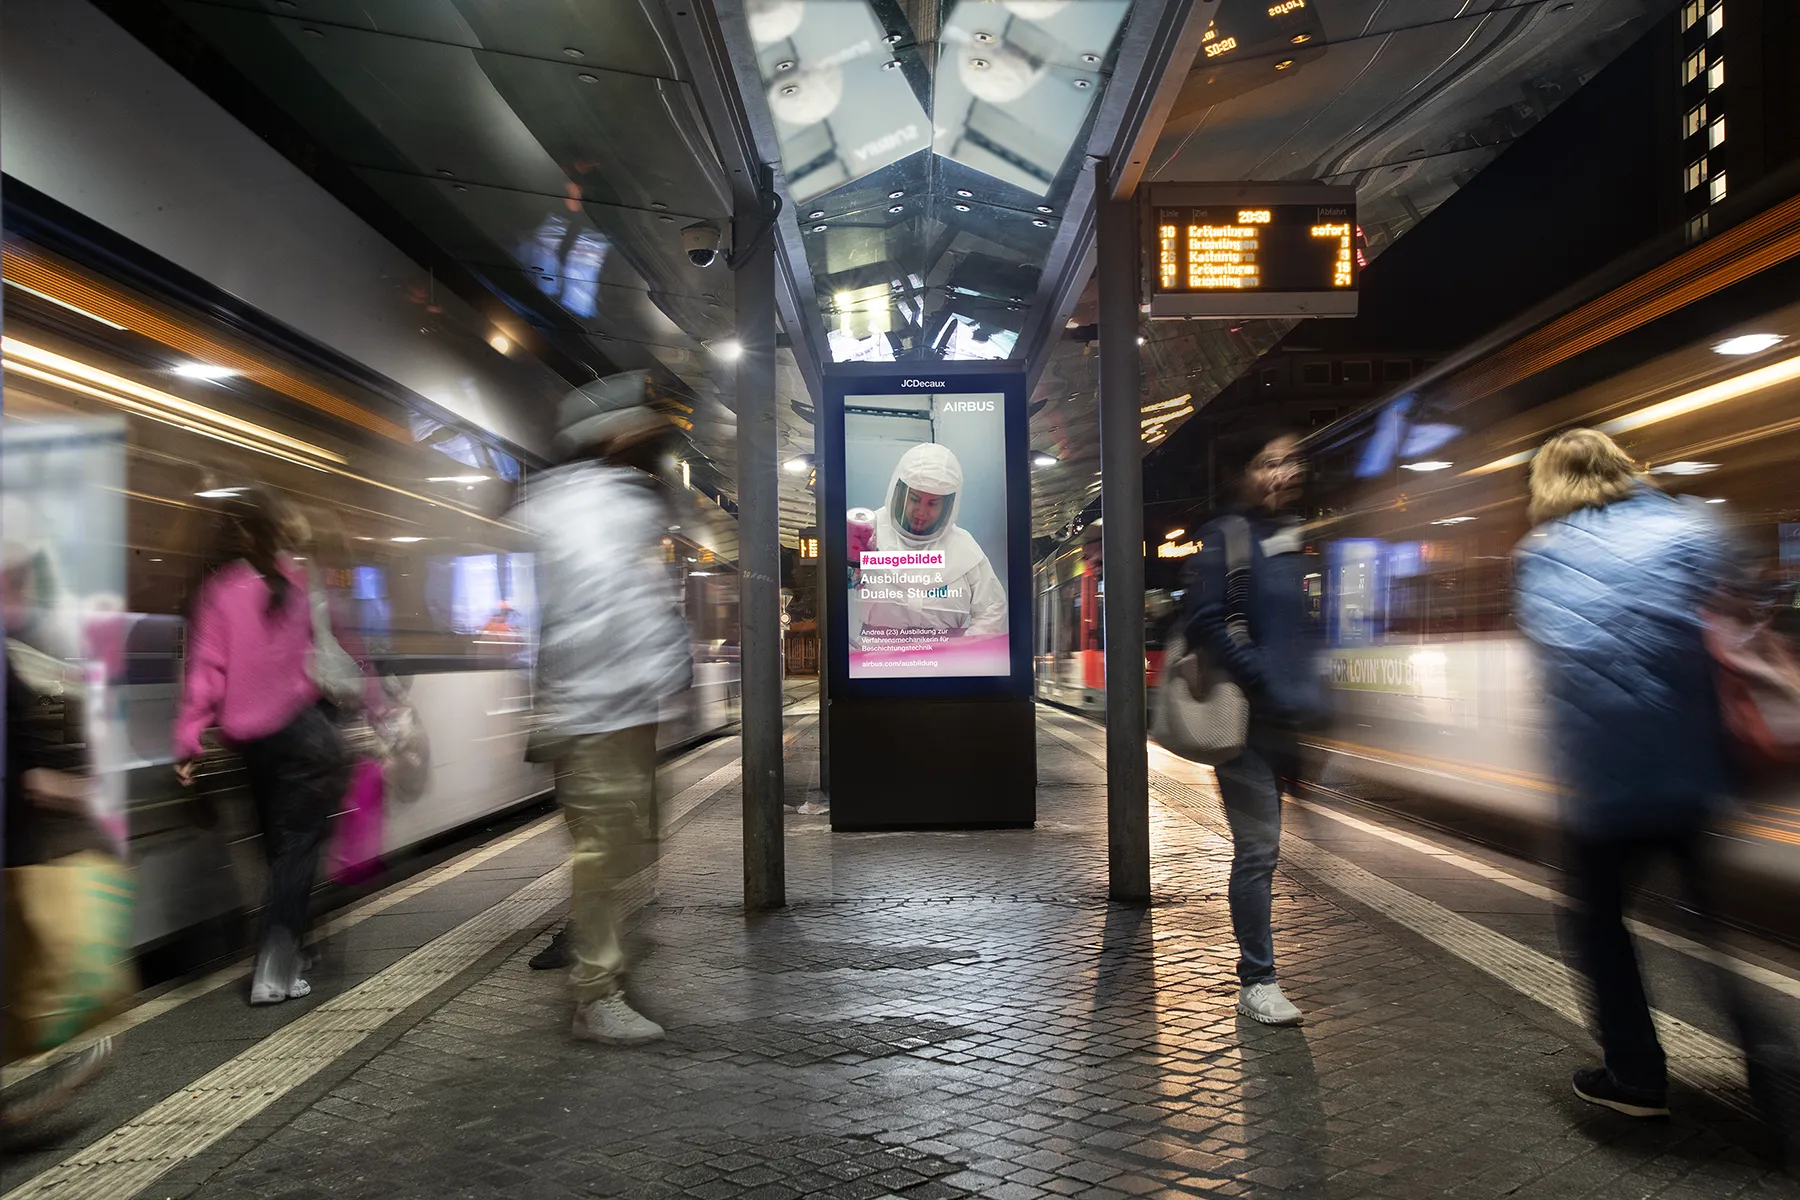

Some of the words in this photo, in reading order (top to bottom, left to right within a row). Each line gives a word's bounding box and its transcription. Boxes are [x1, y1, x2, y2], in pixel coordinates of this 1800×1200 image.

[1319, 208, 1347, 216] Abfahrt
[1311, 223, 1350, 237] sofort
[900, 379, 946, 388] JCDecaux
[942, 401, 995, 412] AIRBUS
[862, 553, 943, 567] #ausgebildet
[860, 573, 931, 585] Ausbildung
[934, 572, 943, 583] &
[861, 588, 904, 599] Duales
[907, 586, 963, 598] Studium!
[886, 629, 899, 637] (23)
[900, 628, 936, 636] Ausbildung
[861, 644, 933, 652] Beschichtungstechnik
[861, 659, 938, 668] airbus.com/ausbildung
[1381, 659, 1402, 685] YOU
